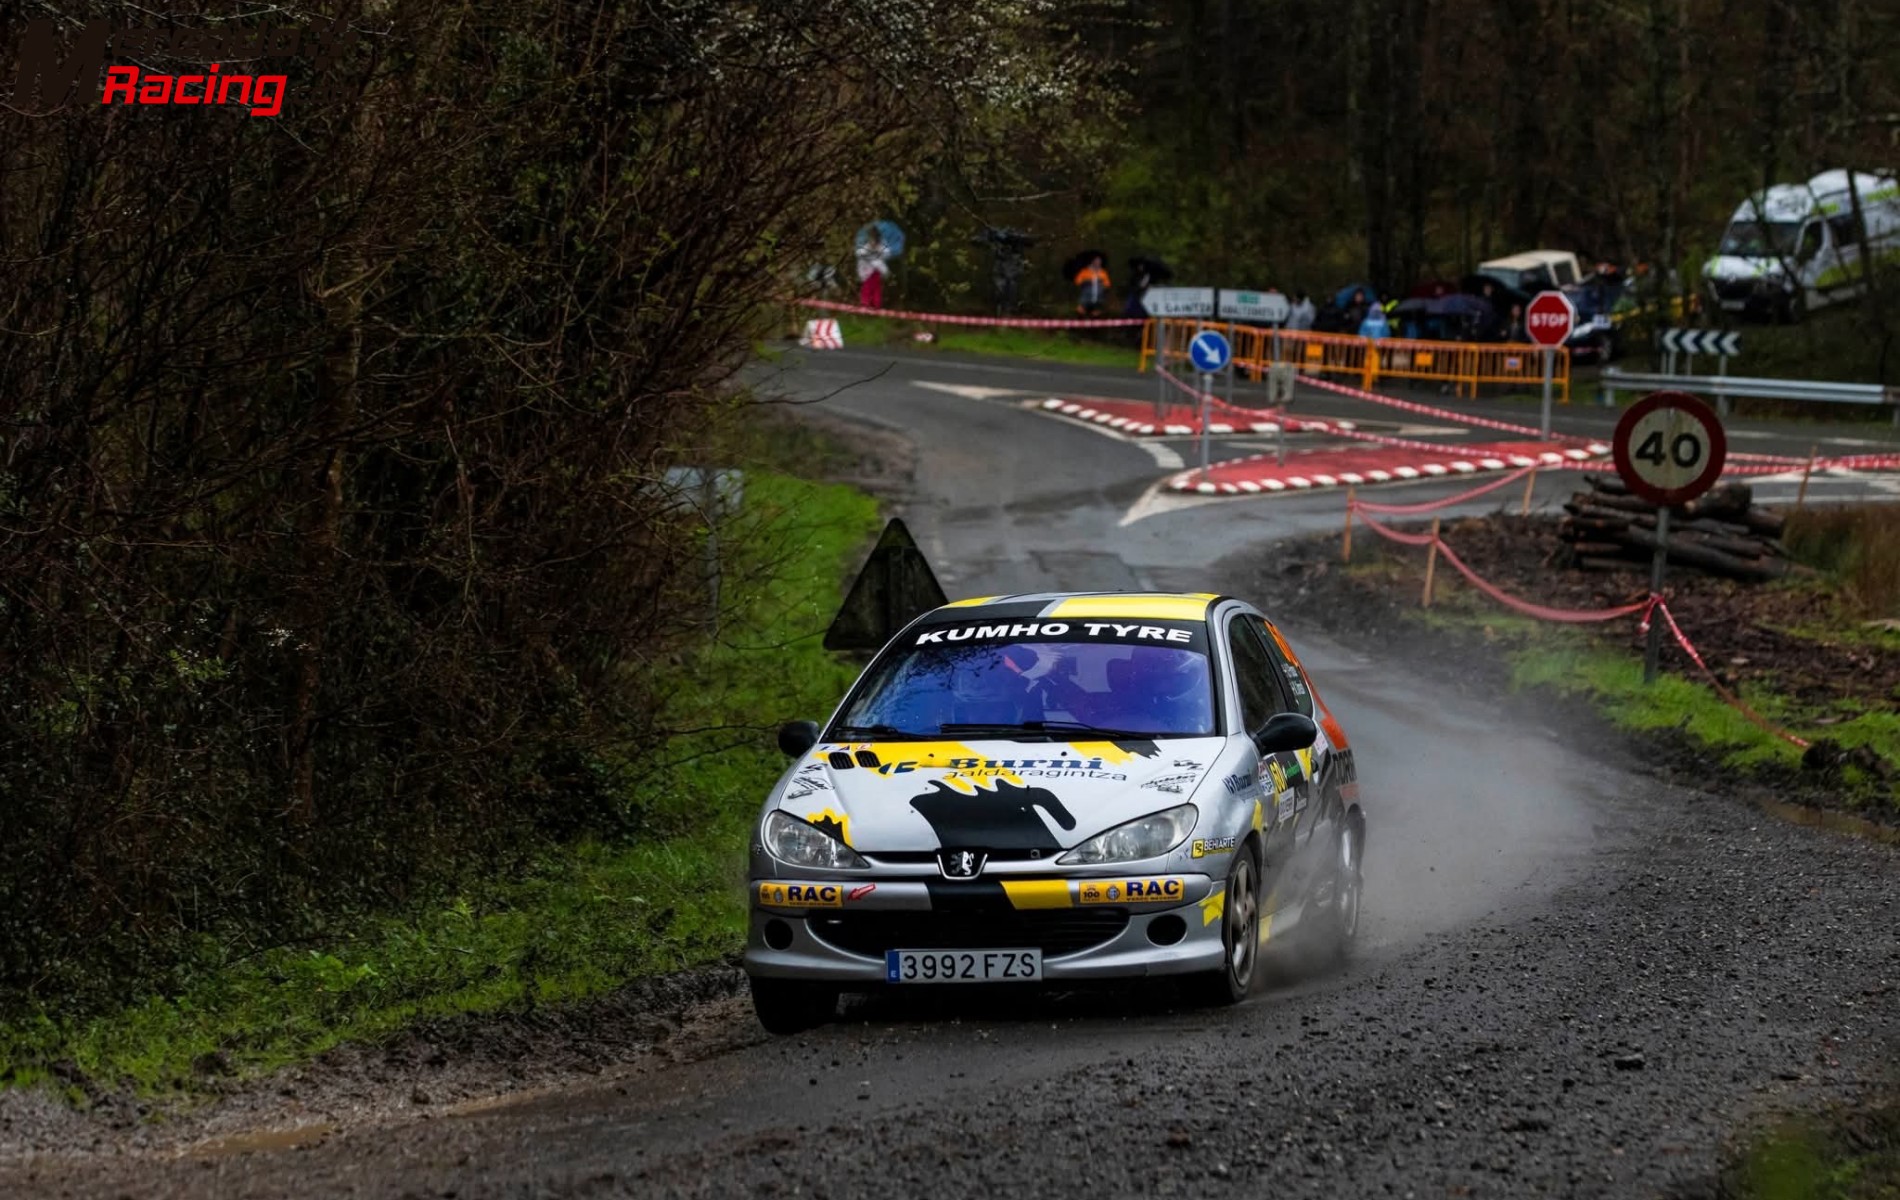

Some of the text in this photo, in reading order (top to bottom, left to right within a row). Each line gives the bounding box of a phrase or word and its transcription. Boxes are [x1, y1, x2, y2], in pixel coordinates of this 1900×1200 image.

[1530, 313, 1568, 327] STOP
[1635, 431, 1701, 468] 40
[915, 623, 1193, 646] KUMHO TYRE
[950, 757, 1103, 769] Burni
[787, 885, 836, 902] RAC
[1083, 891, 1100, 899] 100
[1126, 880, 1179, 897] RAC
[890, 970, 897, 978] E
[903, 953, 1035, 979] 3992 FZS
